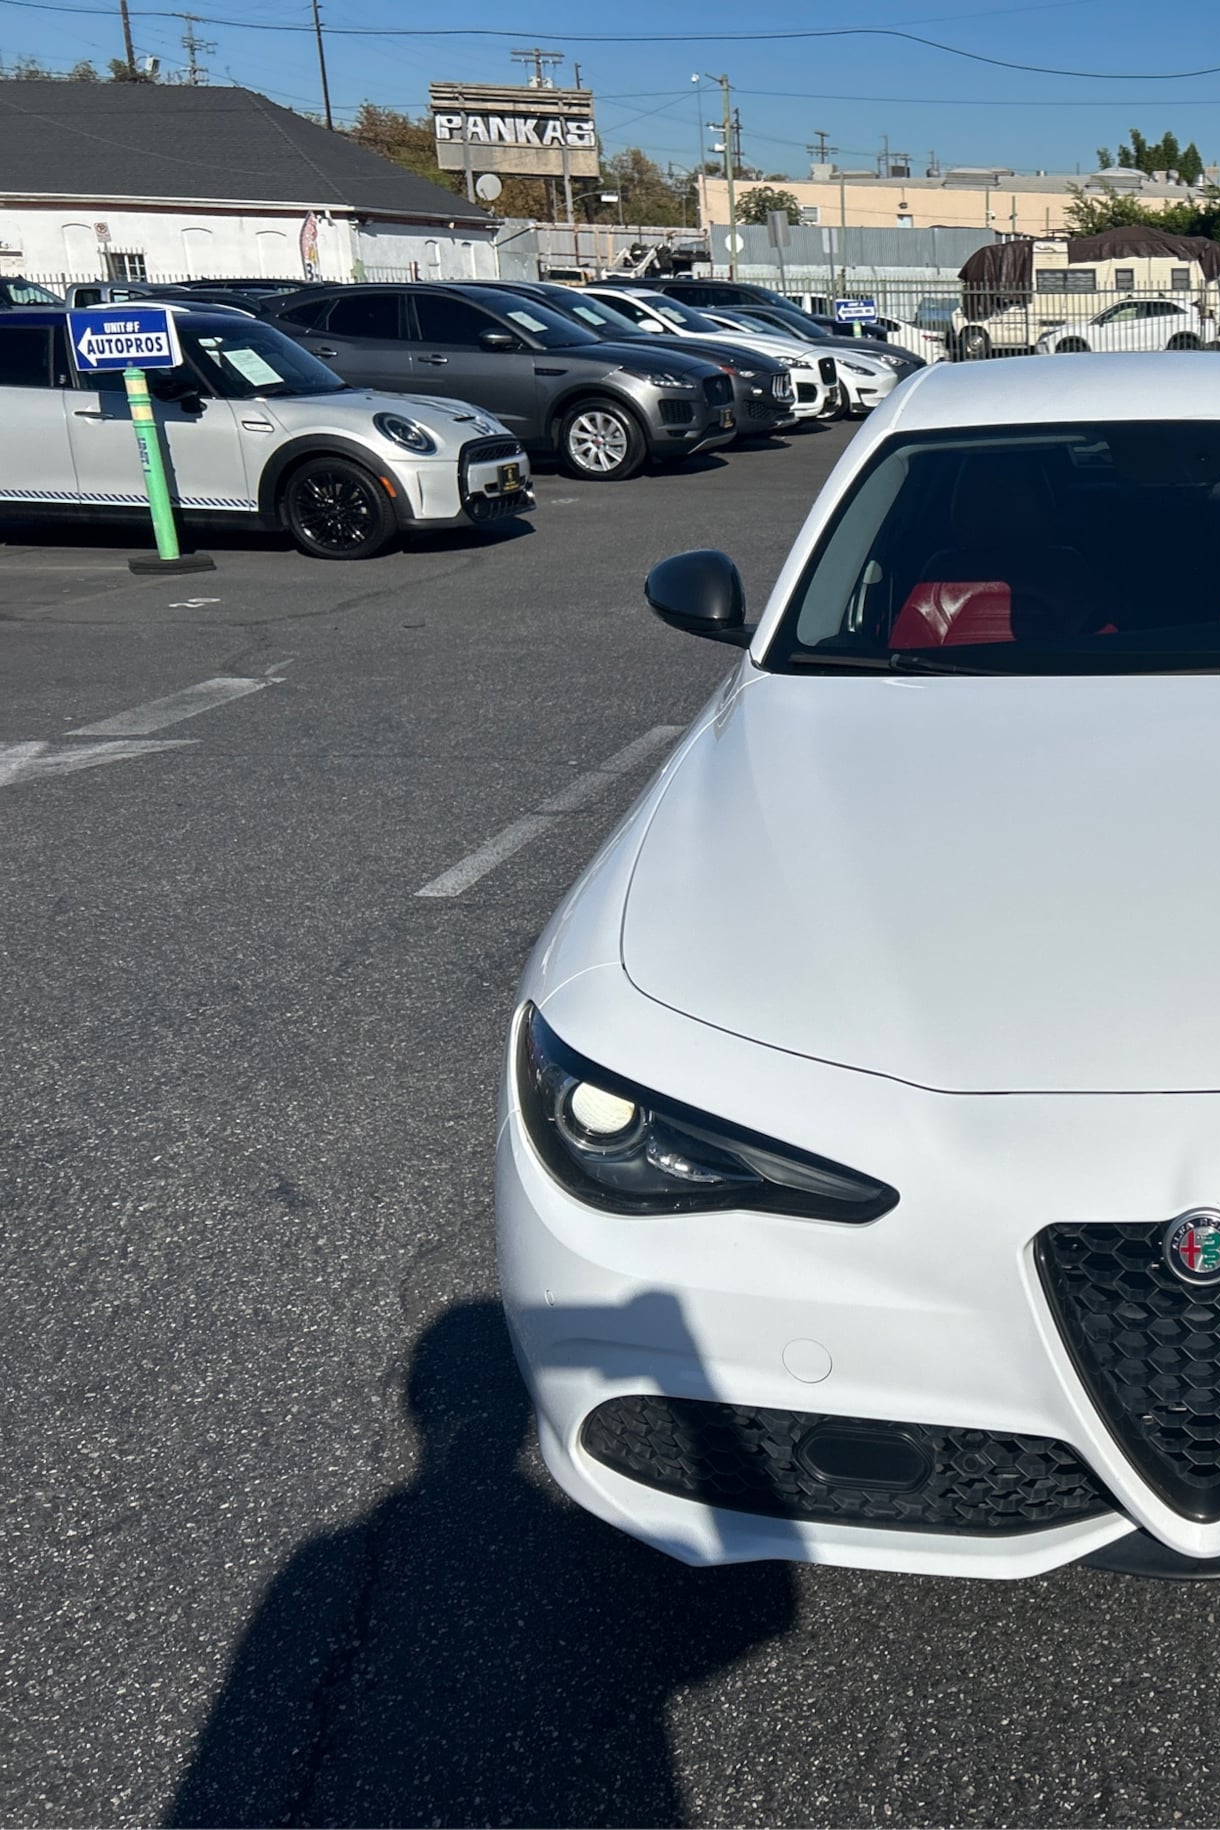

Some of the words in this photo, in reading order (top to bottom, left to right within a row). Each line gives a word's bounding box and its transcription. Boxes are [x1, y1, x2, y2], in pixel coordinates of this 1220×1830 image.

[435, 113, 595, 147] PANKAS
[87, 336, 163, 355] AUTOPROS
[1172, 1222, 1195, 1250] ALFA
